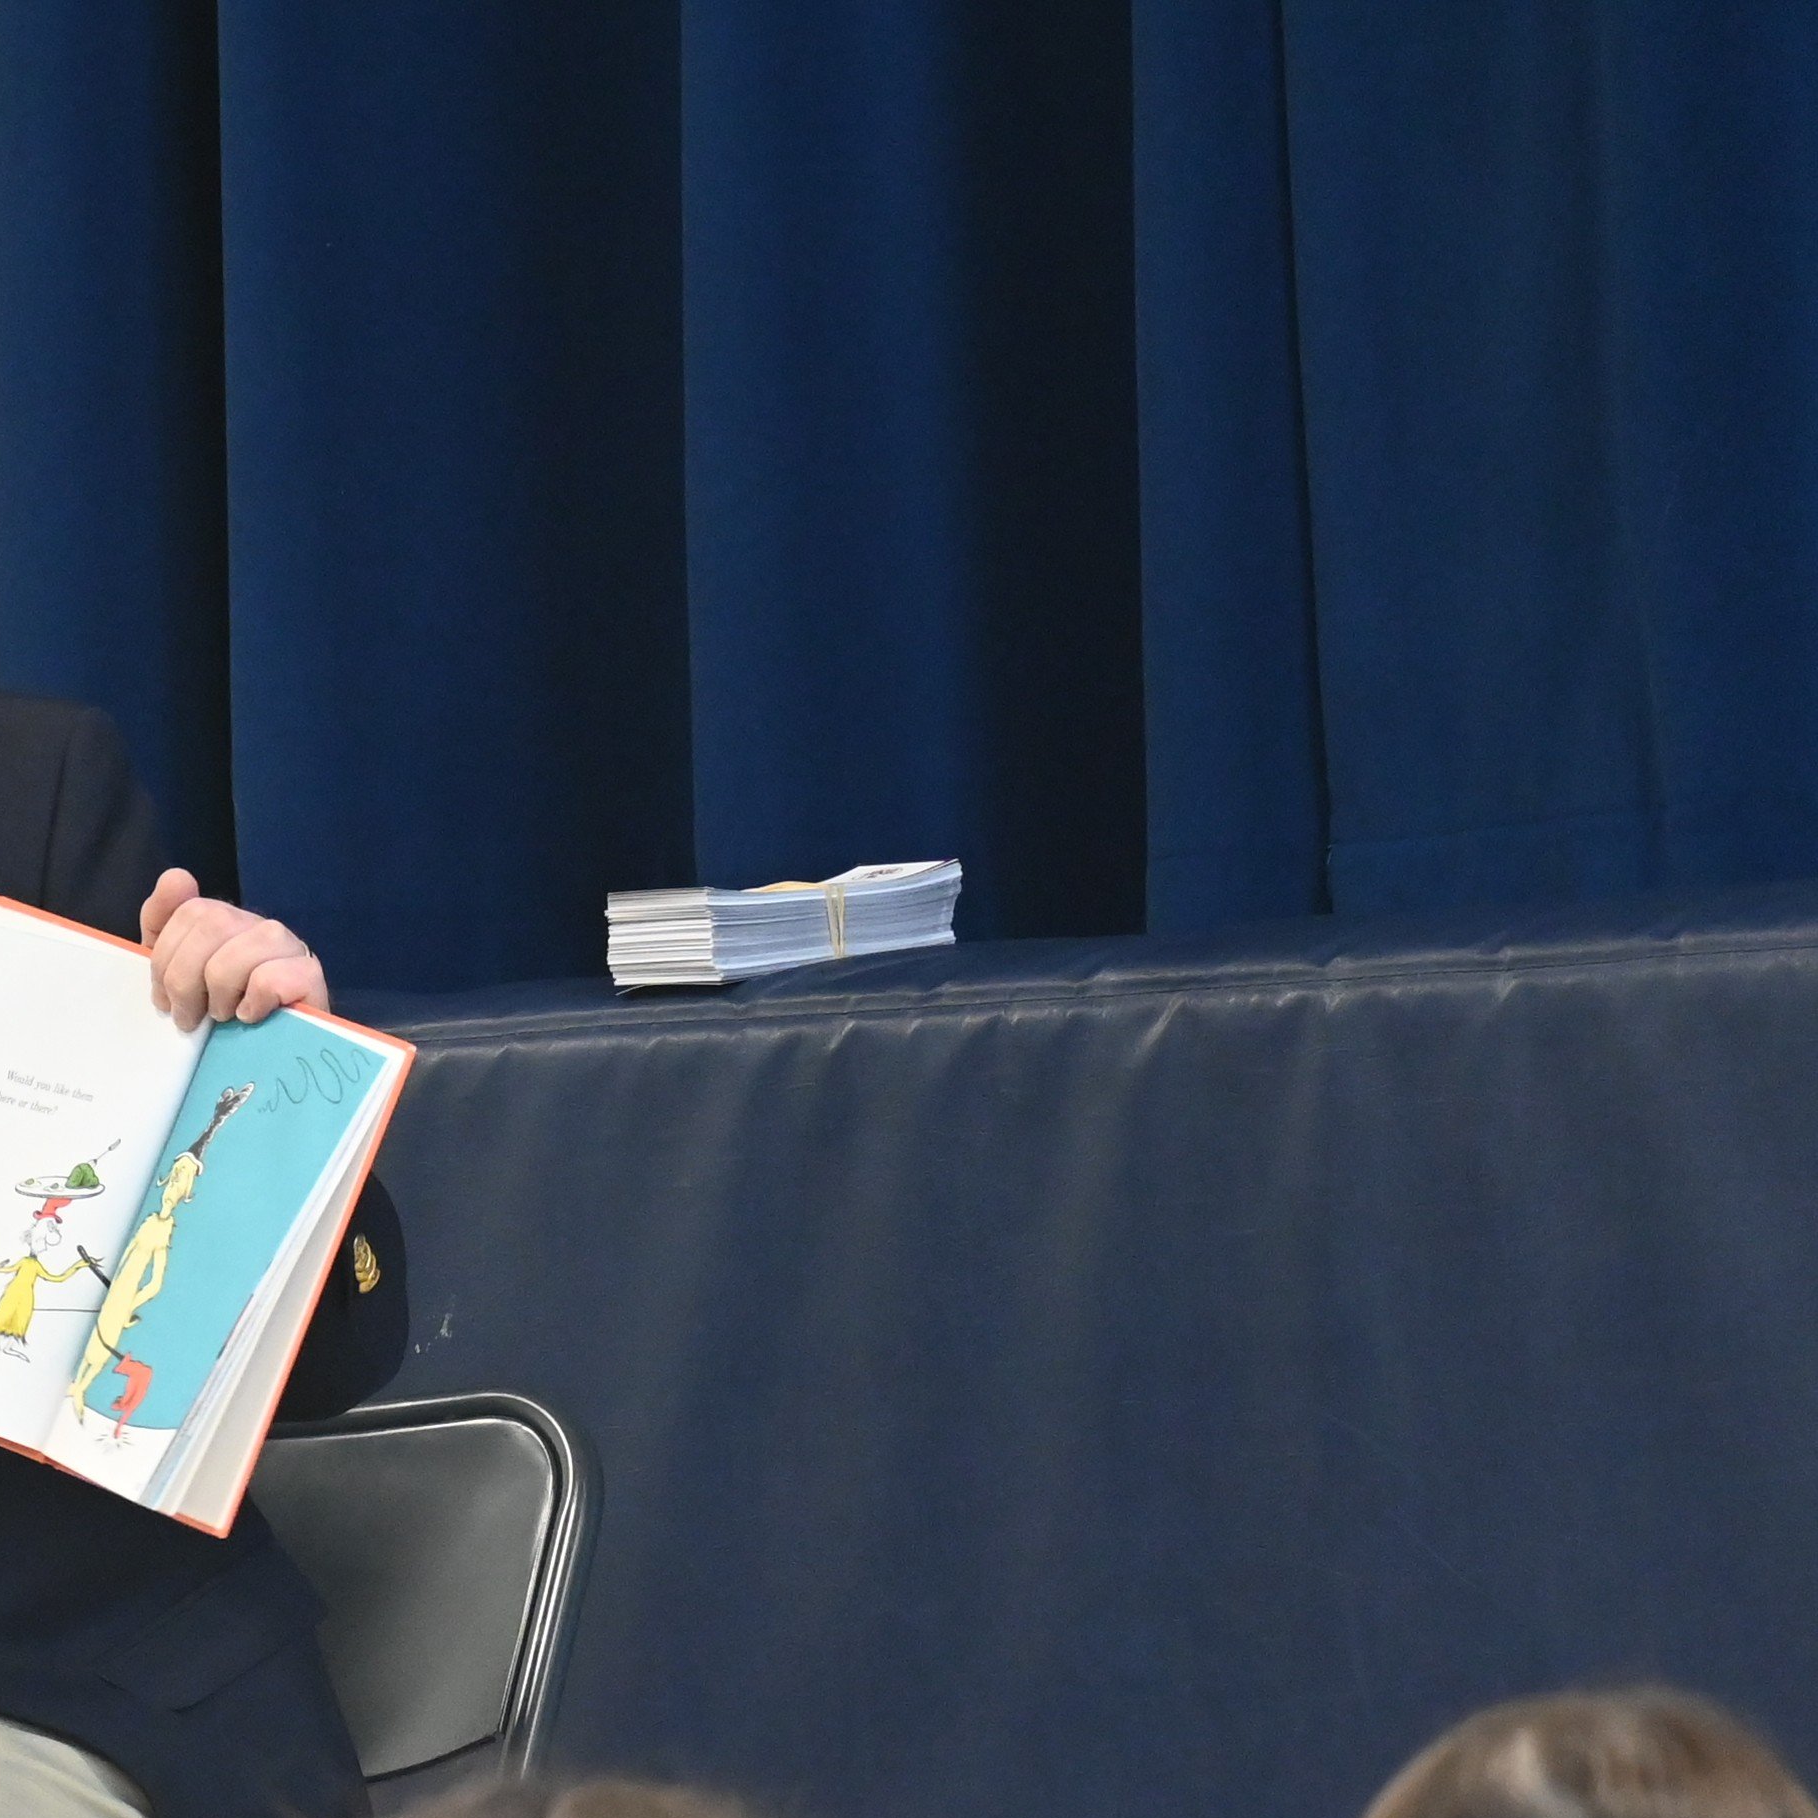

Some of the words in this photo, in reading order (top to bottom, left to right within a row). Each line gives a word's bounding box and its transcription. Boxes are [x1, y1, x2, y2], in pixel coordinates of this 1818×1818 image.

[7, 1069, 35, 1086] Would
[34, 1081, 51, 1091] you
[53, 1083, 70, 1096] like
[72, 1088, 94, 1102] them
[30, 1101, 59, 1115] there?
